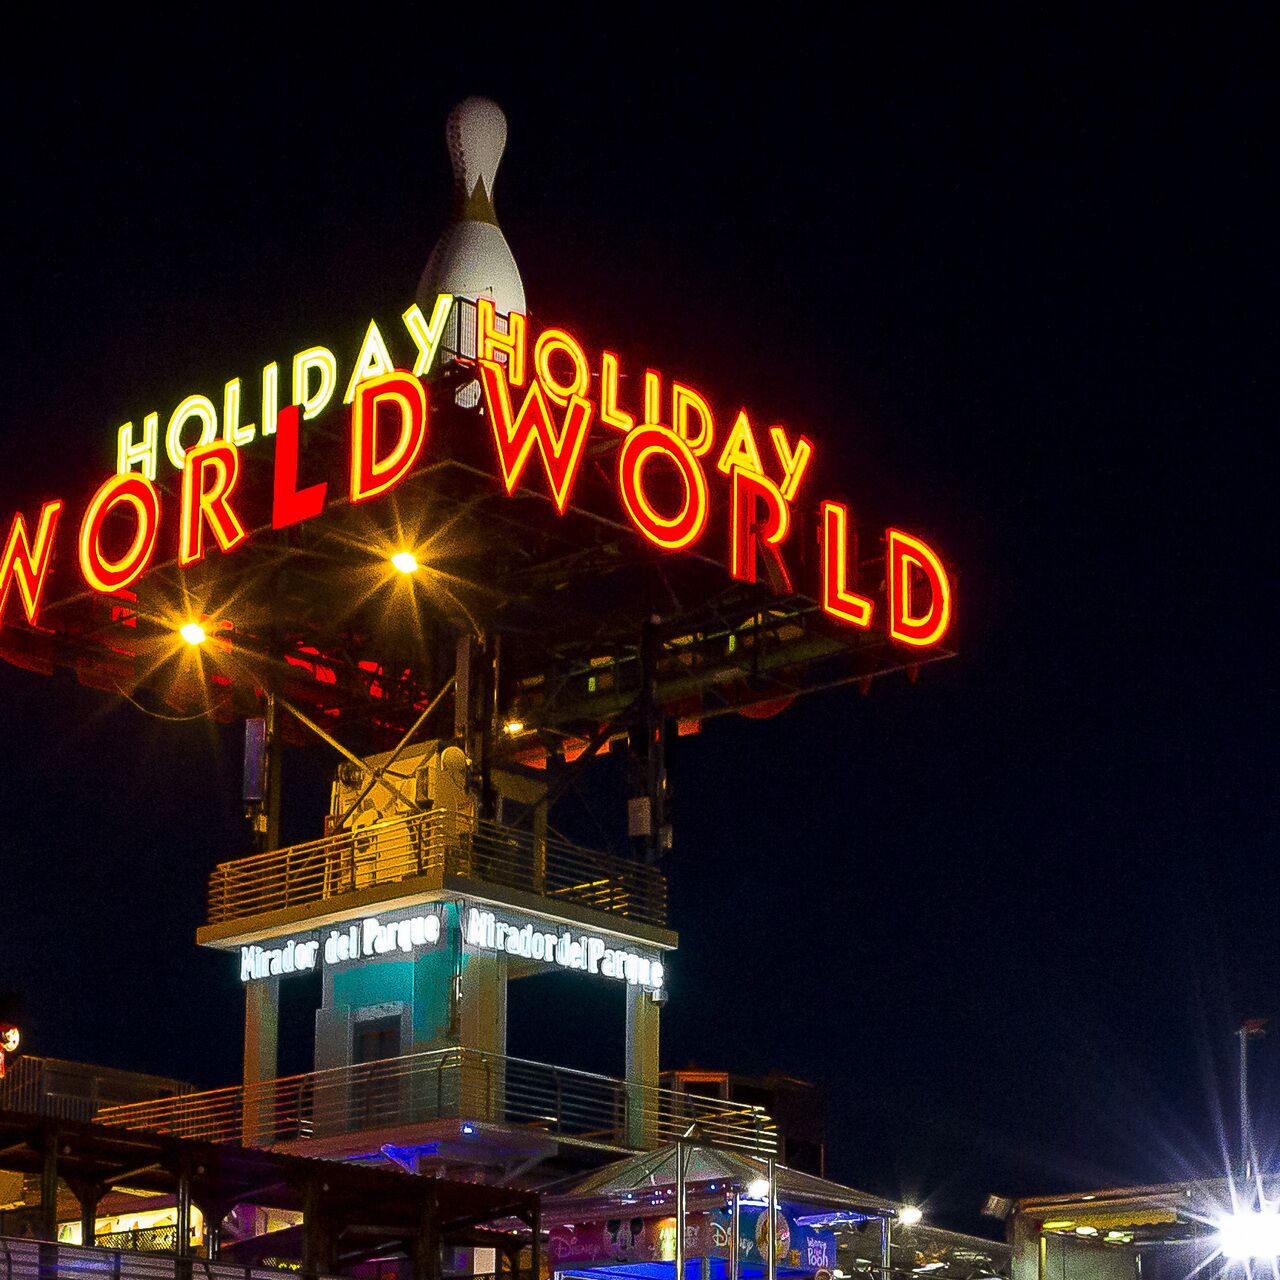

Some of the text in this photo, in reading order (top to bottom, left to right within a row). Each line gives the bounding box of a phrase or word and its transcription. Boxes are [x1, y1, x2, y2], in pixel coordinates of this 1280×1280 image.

[116, 292, 455, 482] HOLIDAY
[476, 296, 815, 503] HOLIDAY
[480, 358, 951, 649] WORLD
[240, 912, 441, 982] Mirador del Parque
[466, 907, 666, 989] Mirador del Parque
[807, 1245, 829, 1268] Pooh
